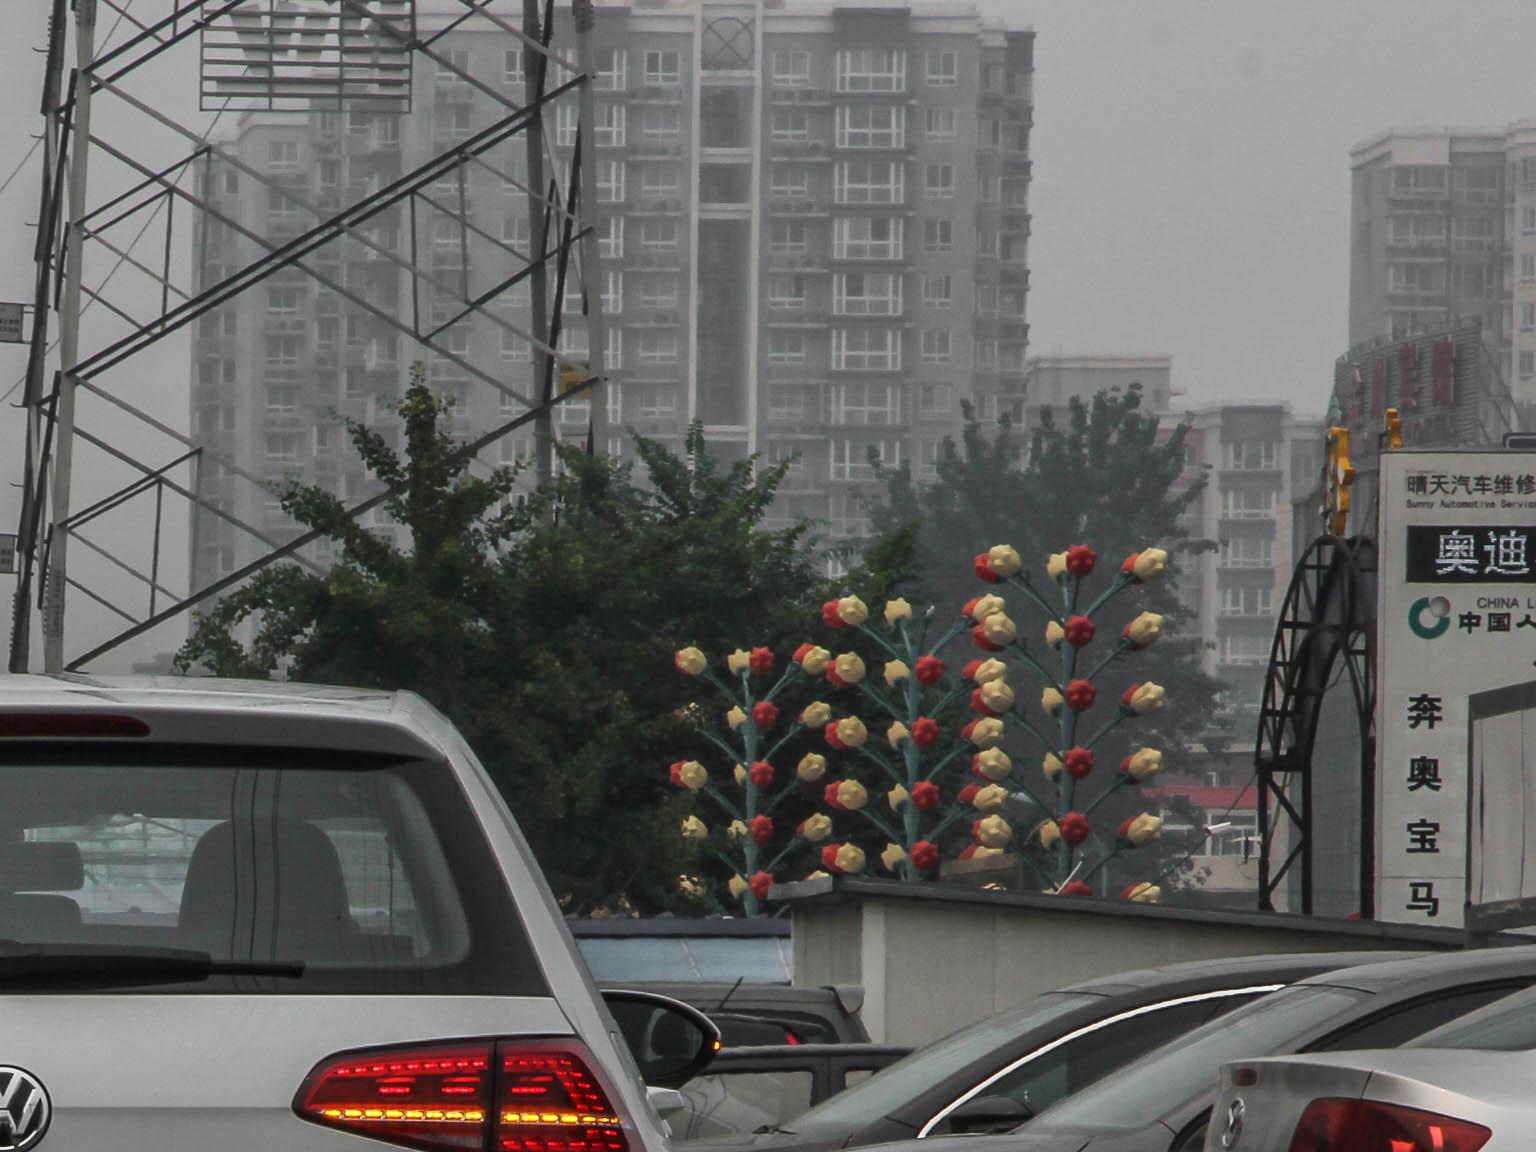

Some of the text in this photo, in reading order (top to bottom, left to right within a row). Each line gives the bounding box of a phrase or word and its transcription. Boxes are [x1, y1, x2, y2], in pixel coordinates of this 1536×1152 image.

[1407, 474, 1536, 496] 晴天汽车维修
[1435, 530, 1536, 575] 奥迪
[1477, 597, 1519, 609] CHINA
